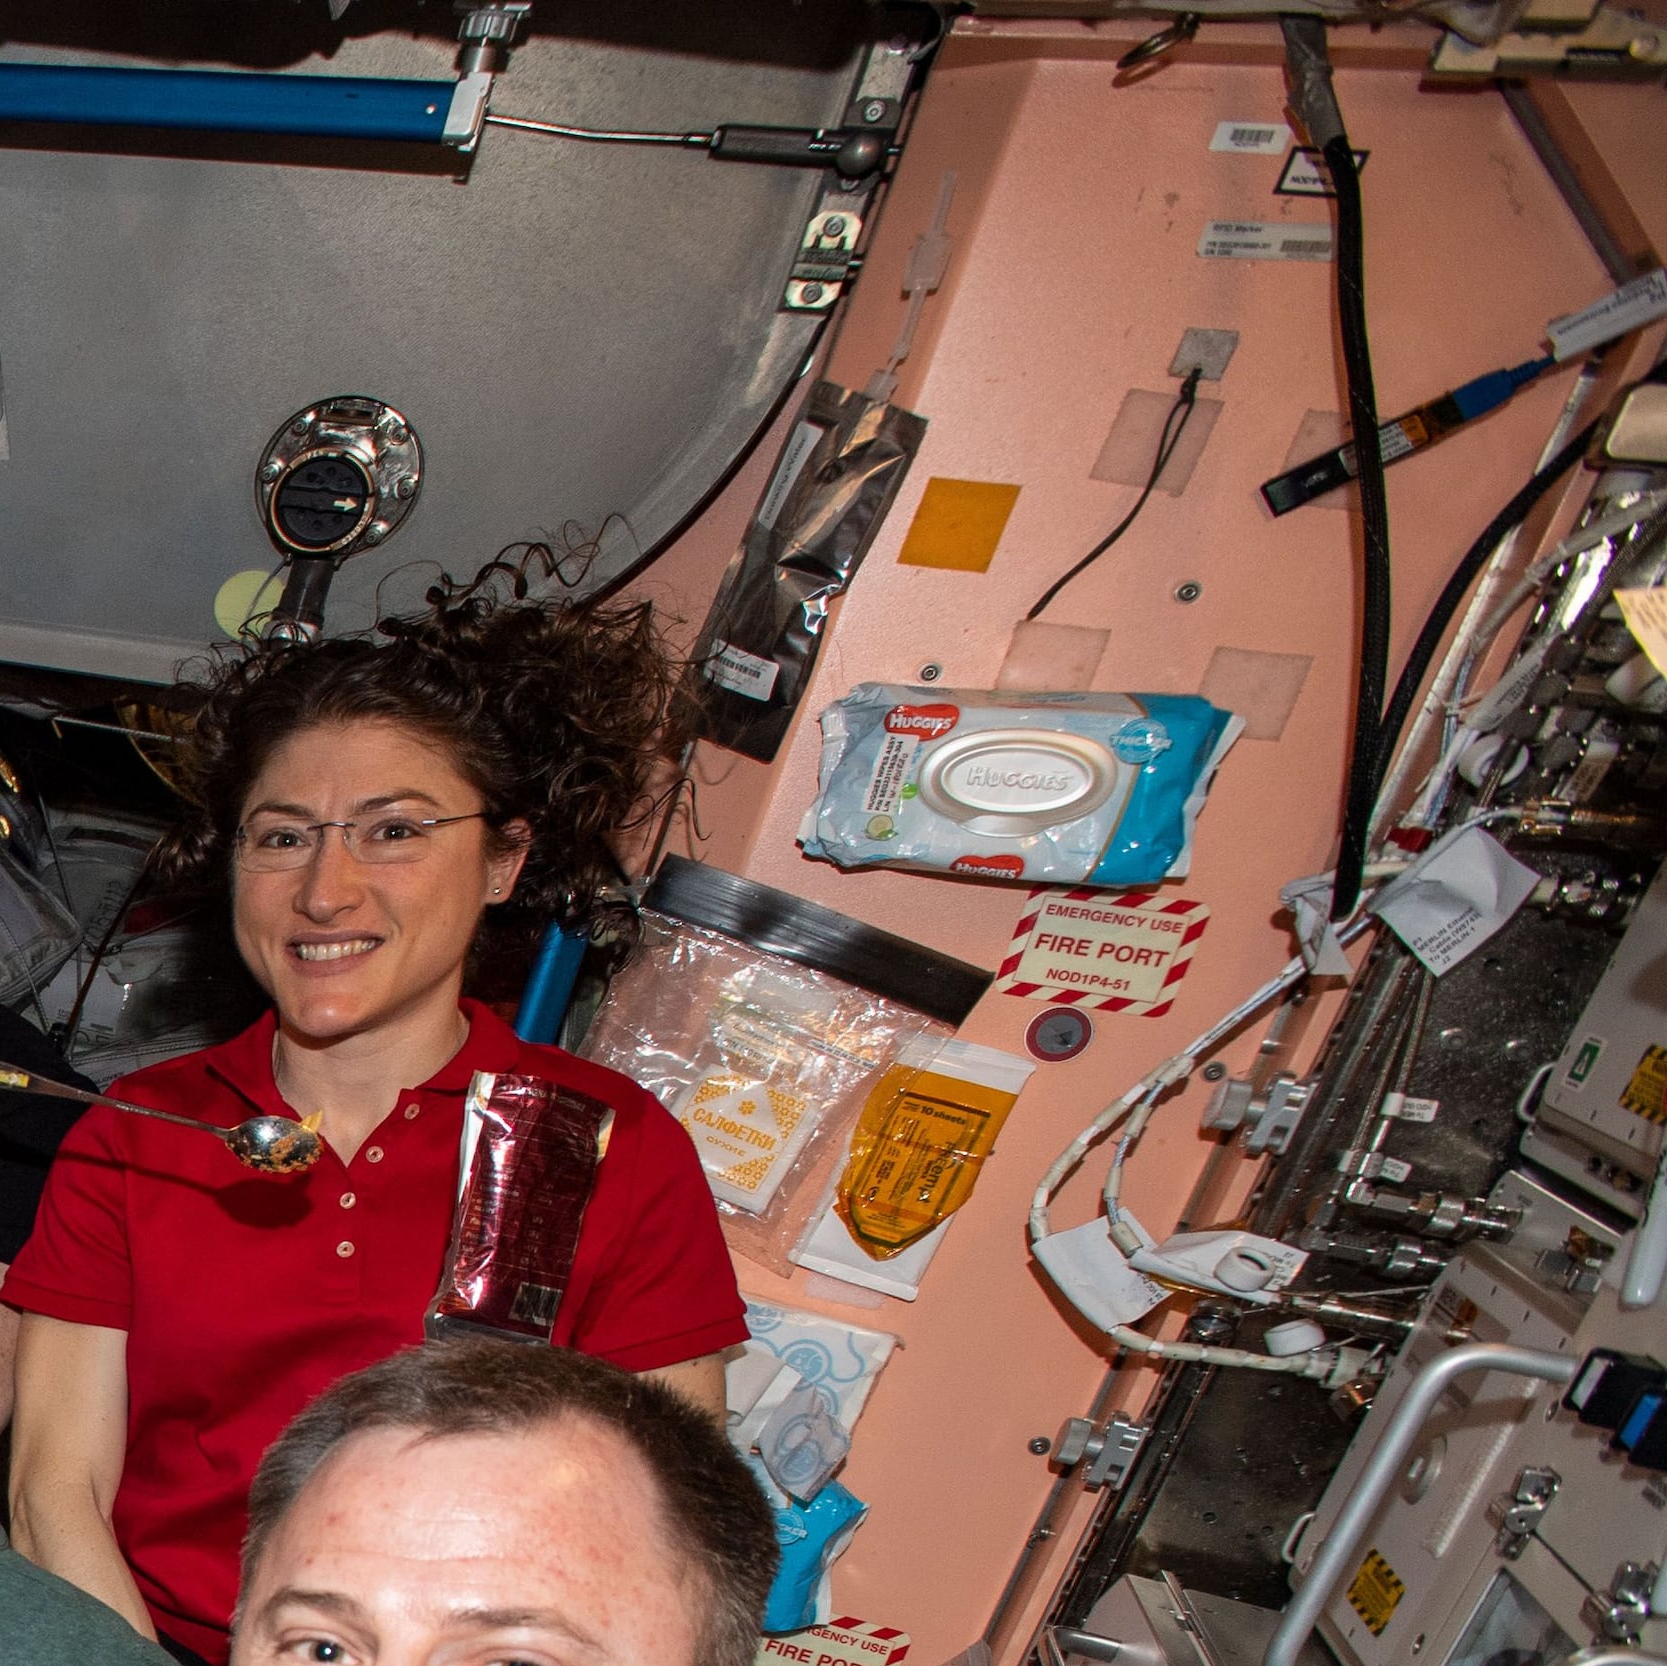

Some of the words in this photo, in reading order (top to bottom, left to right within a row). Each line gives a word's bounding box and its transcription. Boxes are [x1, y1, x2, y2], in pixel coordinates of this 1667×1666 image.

[889, 713, 954, 734] HUGGIES
[966, 765, 1070, 791] HUGGIES
[955, 861, 1017, 880] HUGGIES
[1045, 903, 1146, 929] EMERGENCY
[1149, 920, 1185, 935] USE
[1033, 933, 1094, 958] FIRE
[1097, 942, 1171, 968] PORT
[1045, 968, 1132, 991] NOD1P4-51
[920, 1104, 933, 1116] 10
[933, 1109, 967, 1126] sheets
[692, 1106, 778, 1152] САЛФЕТКИ
[705, 1135, 748, 1158] СУХИЕ
[764, 1639, 814, 1664] FIRE
[860, 1639, 889, 1656] USE
